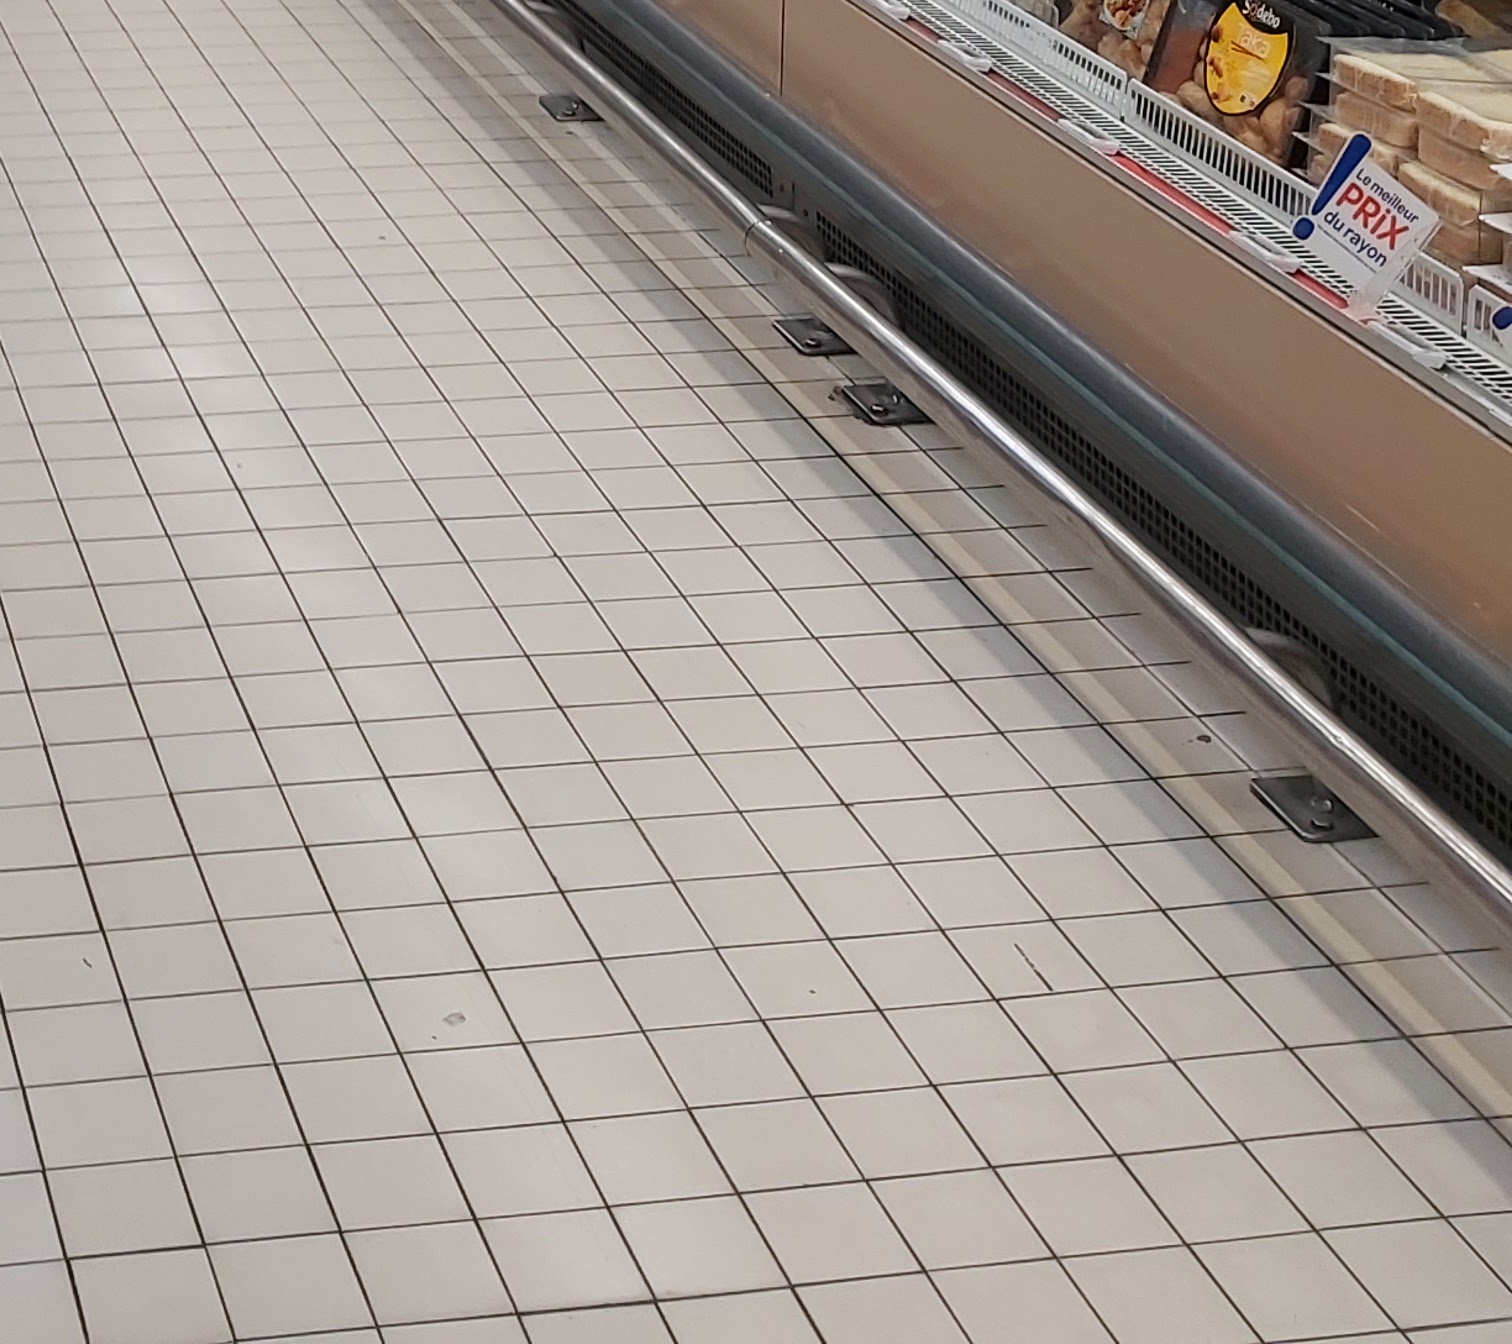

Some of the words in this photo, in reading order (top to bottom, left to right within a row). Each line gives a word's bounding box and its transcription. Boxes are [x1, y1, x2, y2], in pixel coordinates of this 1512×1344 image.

[1356, 168, 1372, 186] Le
[1370, 182, 1420, 223] meilleur
[1324, 211, 1345, 232] du
[1343, 227, 1387, 267] rayon
